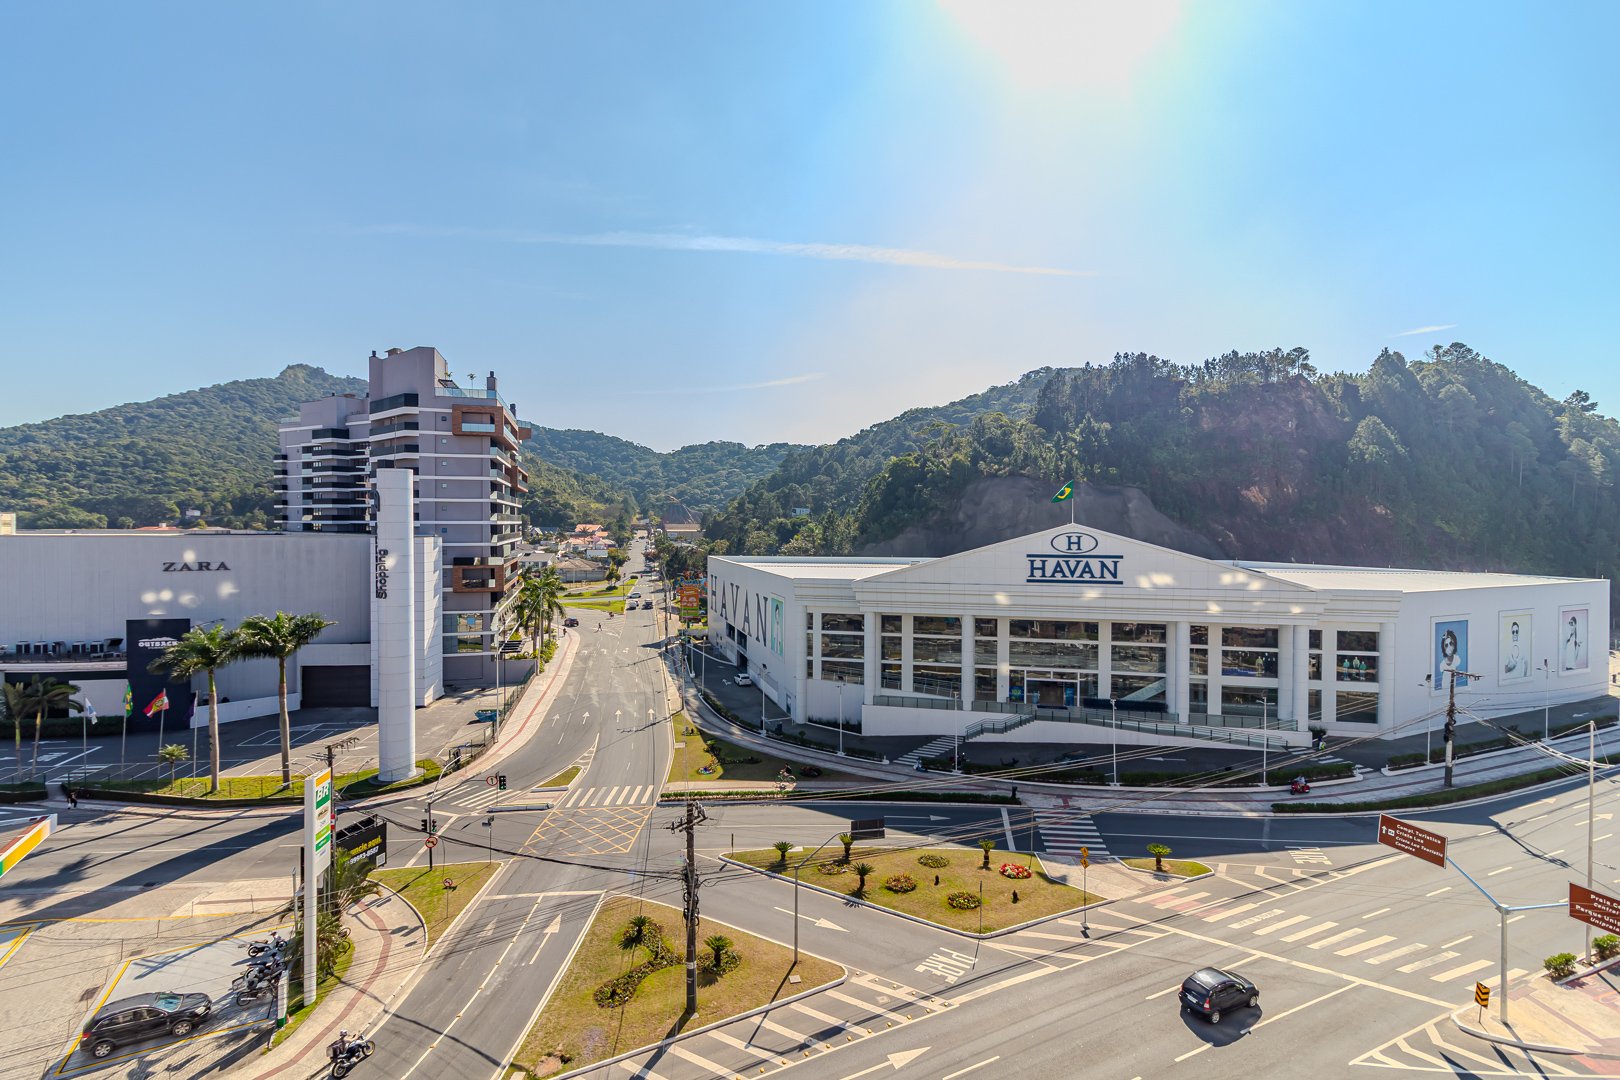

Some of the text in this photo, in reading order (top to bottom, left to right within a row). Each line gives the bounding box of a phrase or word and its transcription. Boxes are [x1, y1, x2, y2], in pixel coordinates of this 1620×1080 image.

[1065, 535, 1083, 551] H
[162, 561, 231, 572] ZARA
[378, 548, 389, 599] Shopping
[1027, 559, 1120, 579] HAVAN
[710, 574, 769, 647] HAVAN
[138, 640, 178, 648] OUTBACK
[316, 783, 329, 802] BR
[1396, 829, 1424, 844] Cristo Luz
[1284, 845, 1334, 866] PARE
[1590, 893, 1611, 906] Praia
[1575, 904, 1603, 919] Parque
[1593, 902, 1620, 916] Central
[1590, 917, 1620, 932] Unipraia
[914, 946, 979, 985] PARE
